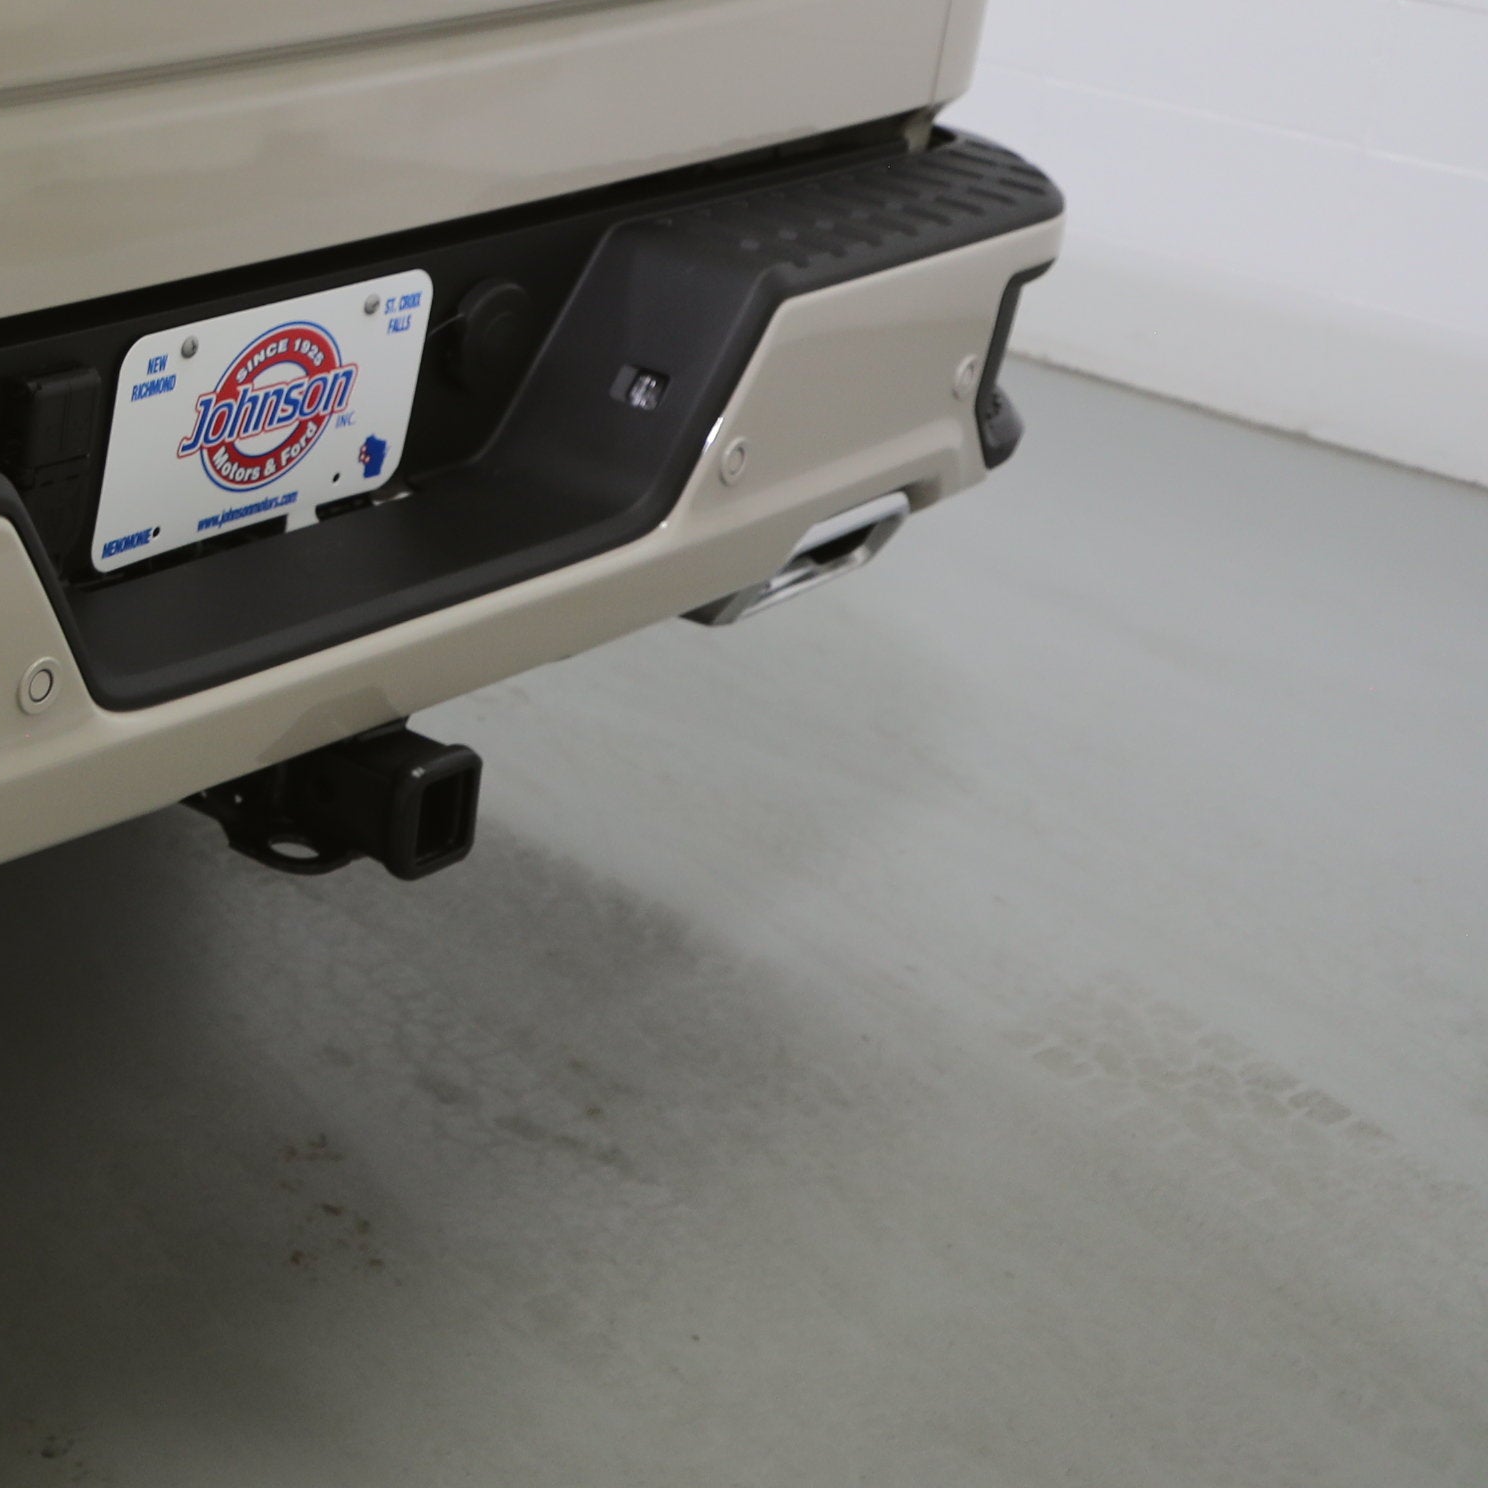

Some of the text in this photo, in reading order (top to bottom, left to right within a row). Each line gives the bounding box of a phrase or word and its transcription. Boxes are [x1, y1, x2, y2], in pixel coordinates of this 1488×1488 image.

[386, 314, 412, 335] FALLS
[146, 353, 169, 375] NEW
[236, 338, 289, 383] SINCE
[130, 373, 177, 403] RICHMOND
[179, 368, 355, 455] Johnson
[212, 421, 317, 482] Motors & Ford
